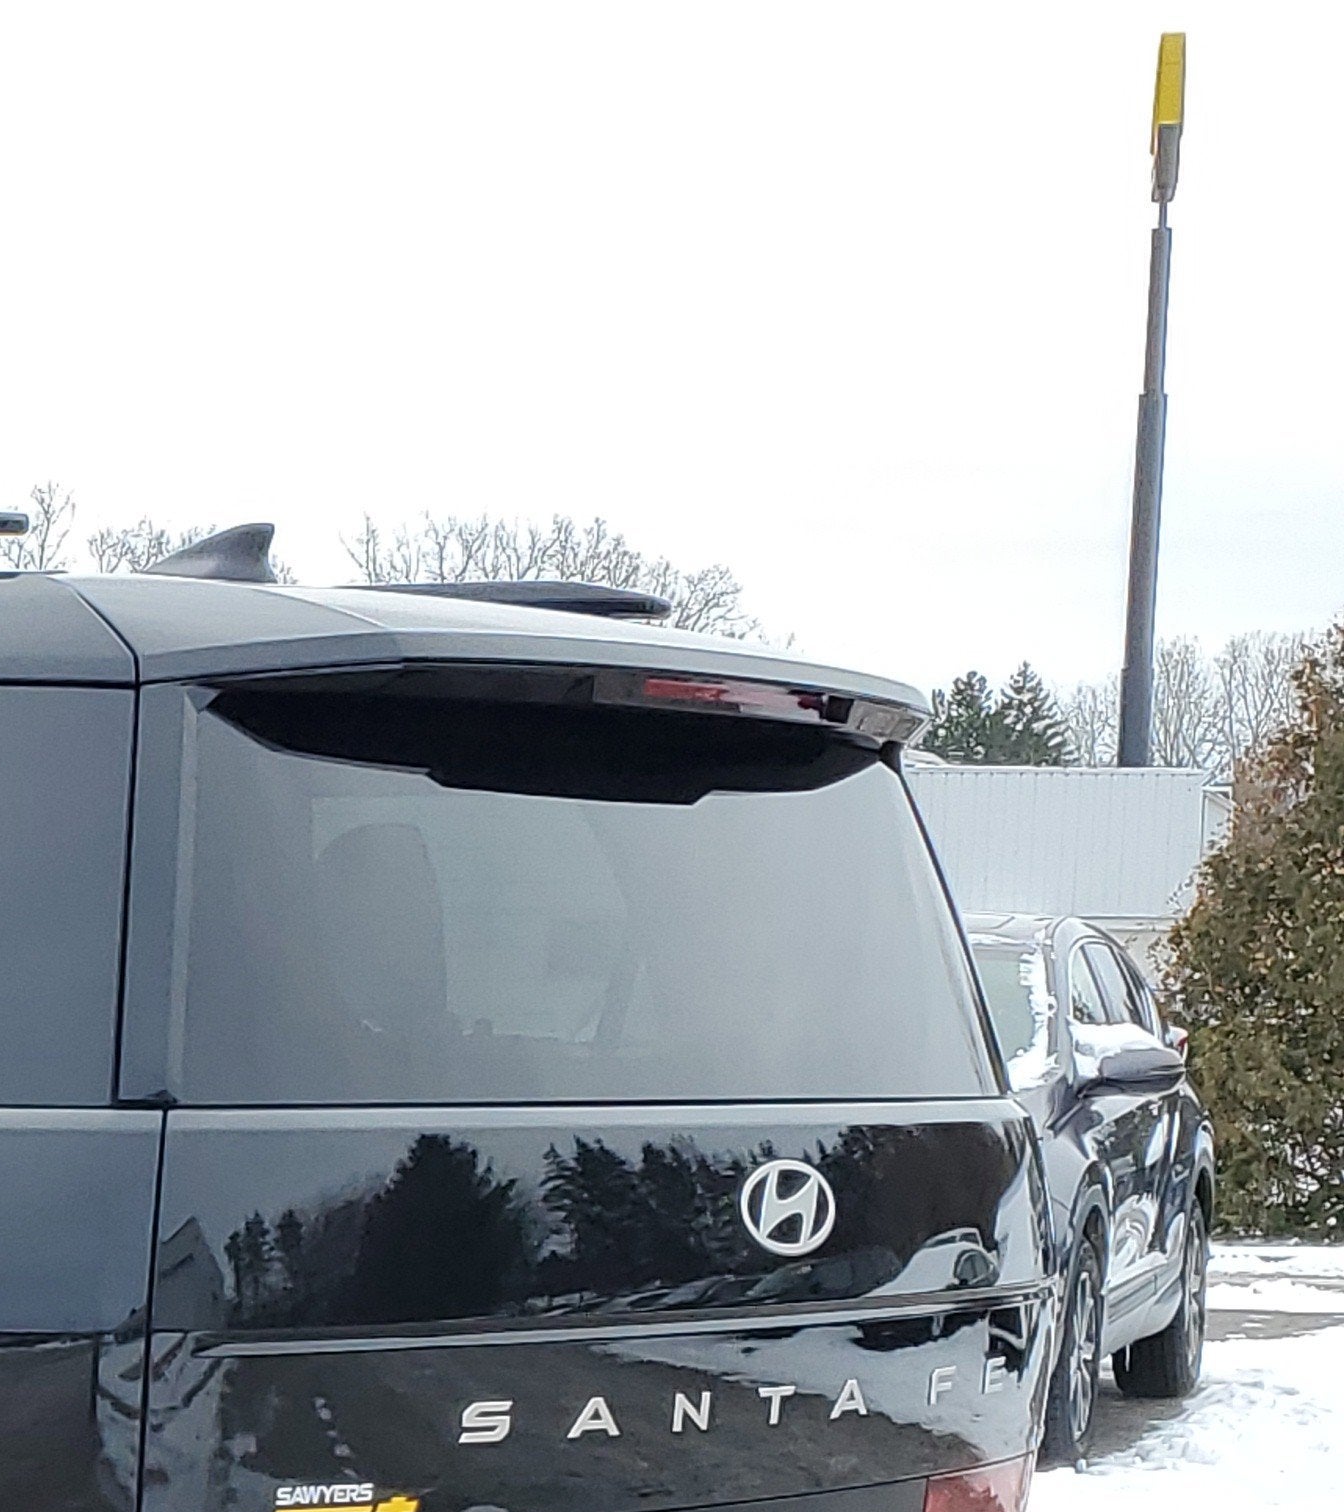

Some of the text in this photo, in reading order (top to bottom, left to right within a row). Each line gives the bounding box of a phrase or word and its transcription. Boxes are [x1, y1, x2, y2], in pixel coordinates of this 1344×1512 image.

[458, 1354, 1007, 1444] SANTA FE
[275, 1482, 374, 1506] SAWYERS
